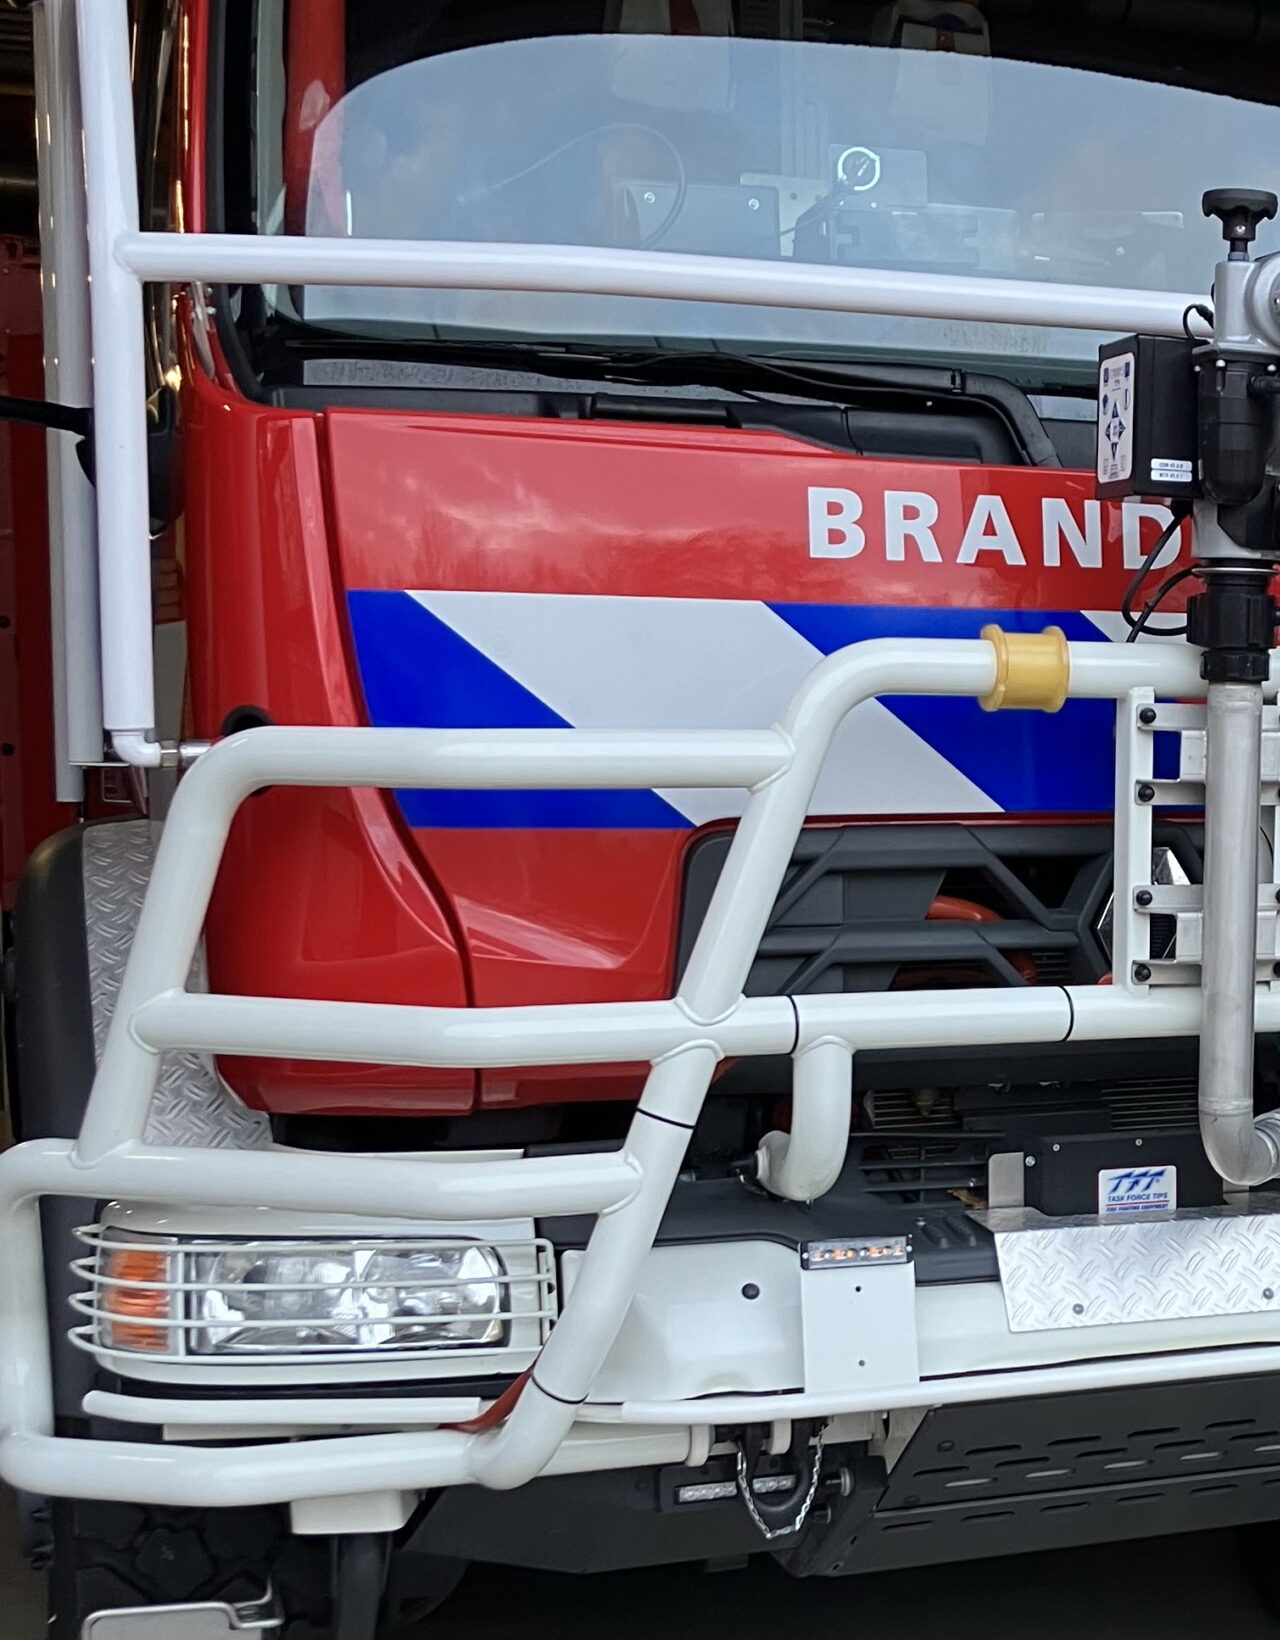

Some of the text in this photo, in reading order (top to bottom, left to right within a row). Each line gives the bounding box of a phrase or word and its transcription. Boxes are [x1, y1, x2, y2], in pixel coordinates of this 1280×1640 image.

[1108, 1192, 1168, 1203] TASK FORCE TIPS
